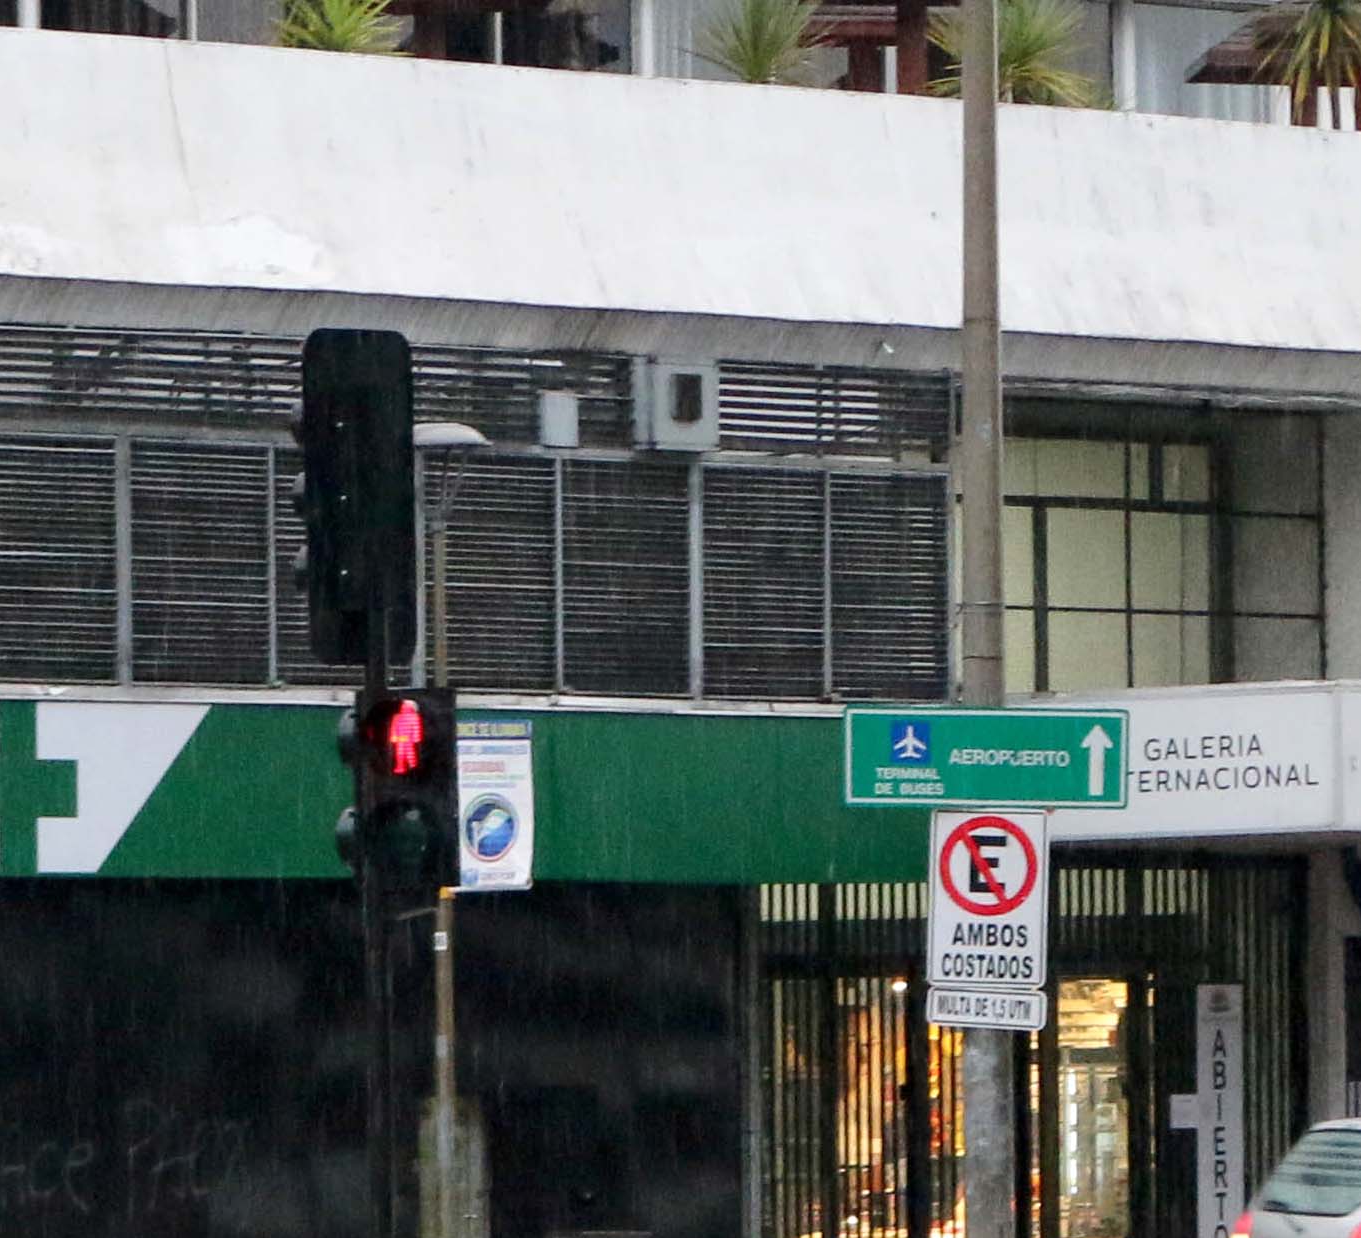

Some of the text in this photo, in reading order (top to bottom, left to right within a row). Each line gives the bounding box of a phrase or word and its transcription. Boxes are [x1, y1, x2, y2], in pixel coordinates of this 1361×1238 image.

[949, 749, 1070, 767] AEROPUERTO
[1143, 734, 1264, 761] GALERIA
[875, 767, 941, 779] TERMINAL
[1126, 763, 1320, 793] ERNACIONAL
[875, 782, 893, 795] DE
[951, 922, 1029, 948] AMBOS
[941, 953, 1034, 979] COSTADOS
[937, 995, 972, 1016] MULTA
[975, 997, 989, 1017] DE
